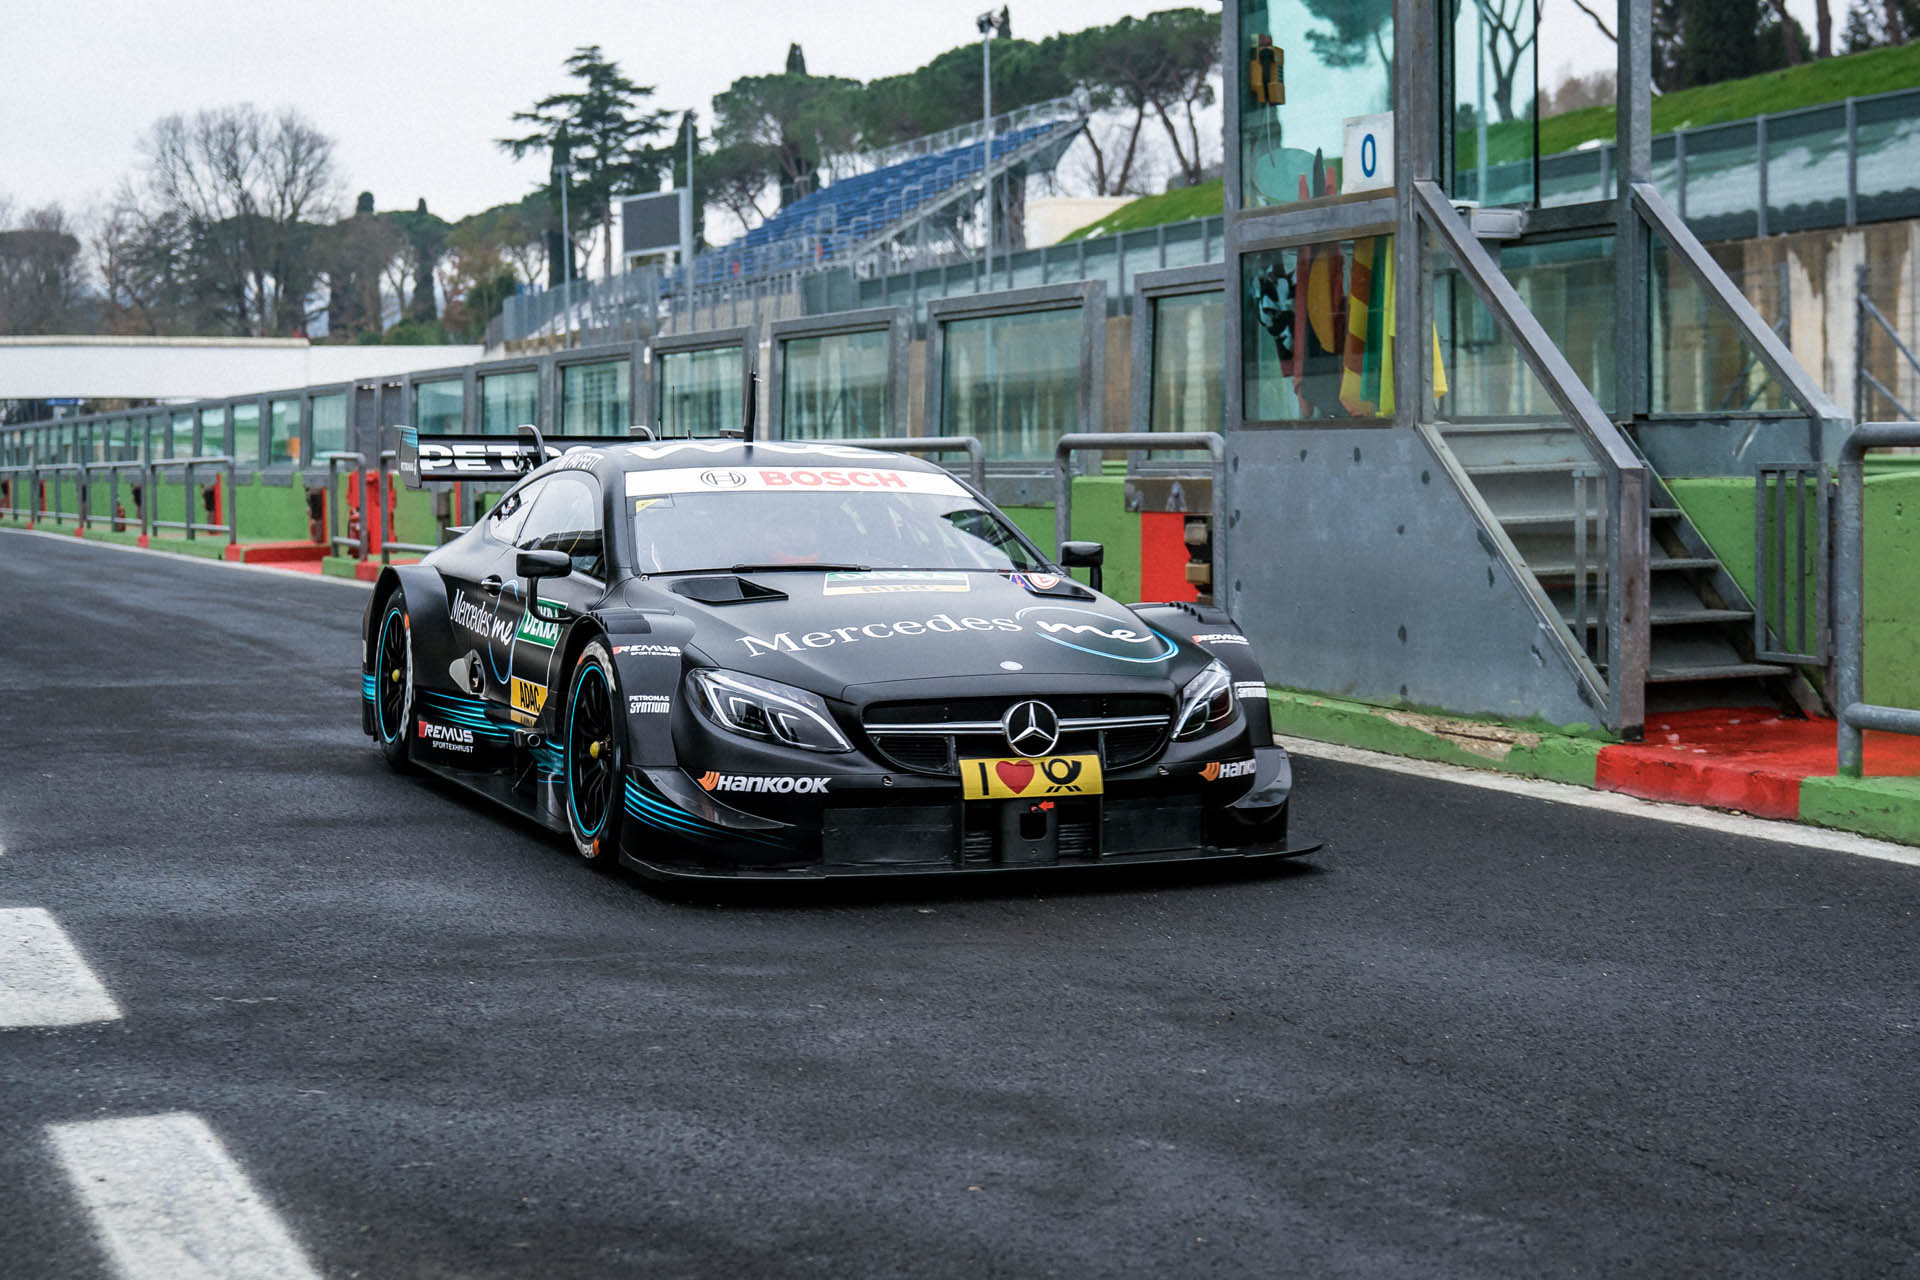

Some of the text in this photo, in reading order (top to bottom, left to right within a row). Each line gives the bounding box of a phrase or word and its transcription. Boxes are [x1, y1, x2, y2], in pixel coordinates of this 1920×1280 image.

[1361, 133, 1376, 178] 0
[760, 471, 907, 488] BOSCH
[450, 588, 513, 646] Mercedes me
[616, 645, 681, 653] REMUS
[735, 613, 1153, 657] Mercedes me
[519, 681, 541, 713] ADAC
[630, 702, 670, 713] SYNTIUM
[424, 724, 474, 743] REMUS
[978, 762, 990, 796] I
